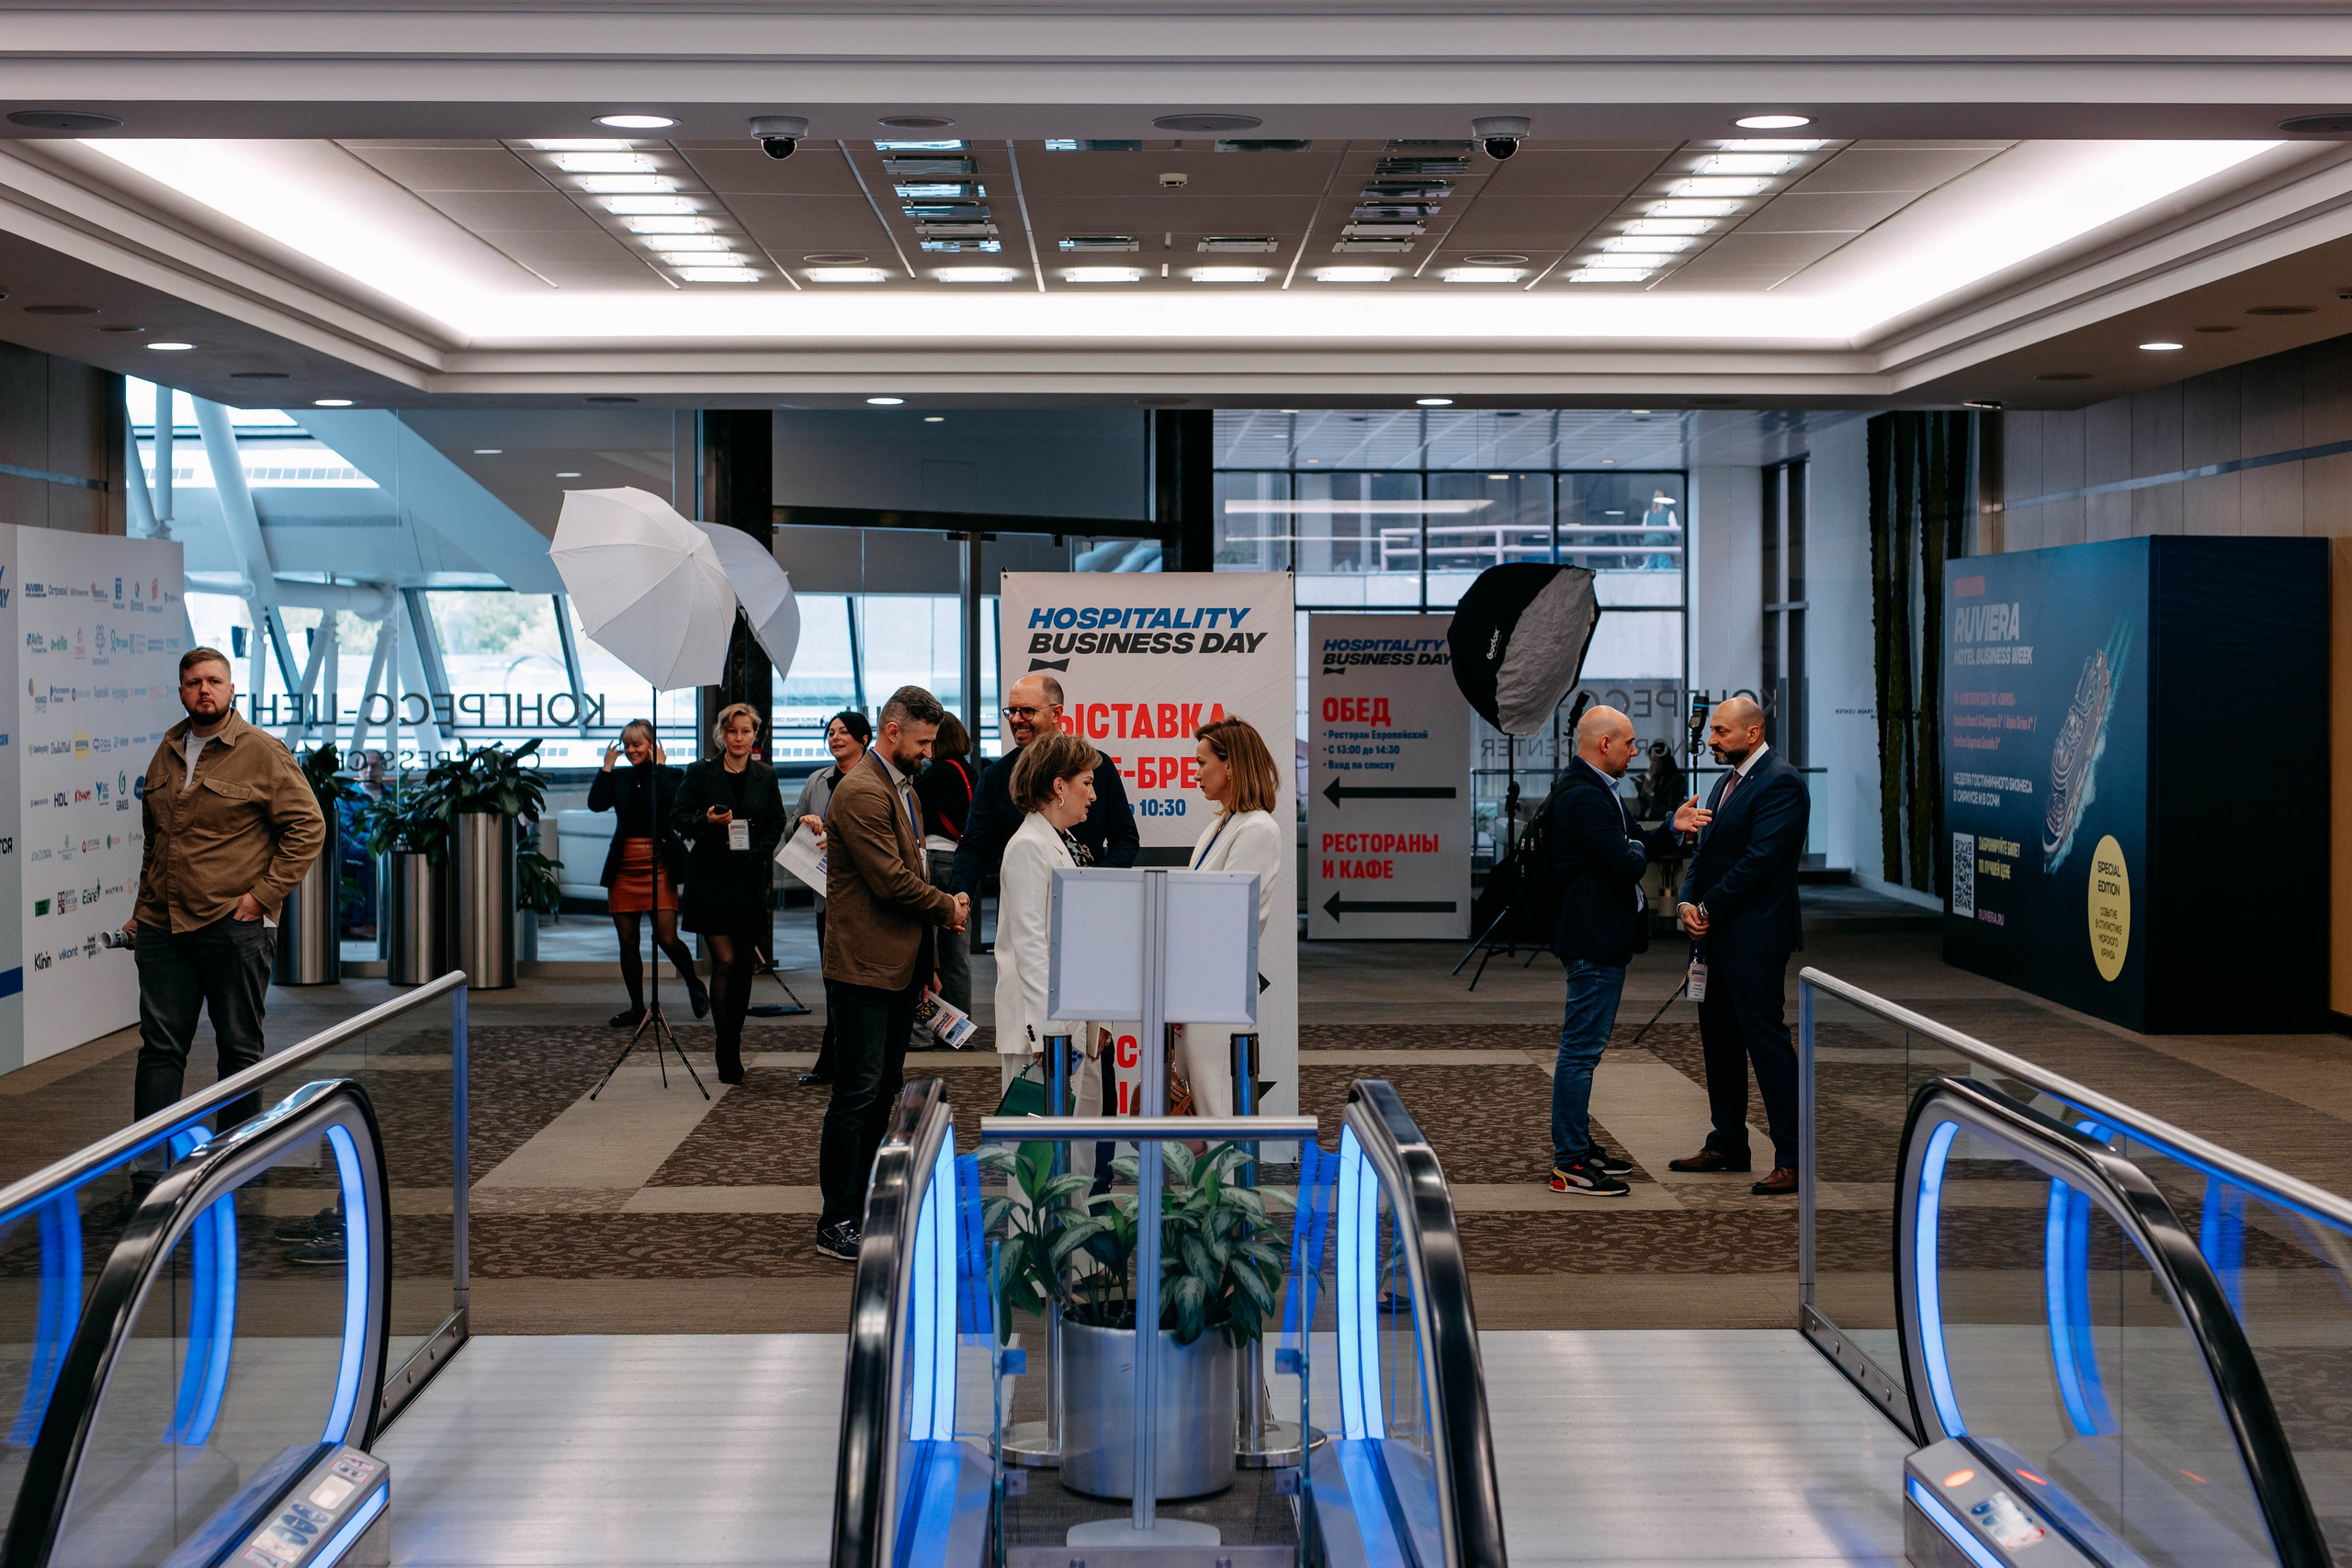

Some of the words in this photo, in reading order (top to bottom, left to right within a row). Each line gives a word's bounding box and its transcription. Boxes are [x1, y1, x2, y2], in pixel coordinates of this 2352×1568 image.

[1028, 608, 1251, 629] HOSPITALITY
[1954, 603, 2019, 643] RUVIERA
[1028, 632, 1195, 654] BUSINESS
[1199, 633, 1268, 653] DAY
[1323, 639, 1445, 651] HOSPITALITY
[1486, 627, 1500, 660] Godox
[1323, 653, 1415, 665] BUSINESS
[1954, 648, 1975, 665] HOTEL
[1976, 647, 2011, 665] BUSINESS
[2012, 646, 2033, 664] WEEK
[1323, 697, 1391, 727] ОБЕД
[1329, 730, 1370, 740] Ресторан
[1372, 730, 1428, 740] Европейский
[1337, 745, 1361, 754] 13:00
[1363, 747, 1374, 756] до
[1376, 745, 1400, 754] 14:30
[1329, 760, 1351, 771] Вход
[1364, 761, 1395, 771] списку
[1953, 773, 1972, 787] НЕДЕЛЯ
[1972, 773, 2009, 791] ГОСТИНИЧНОГО
[2009, 777, 2033, 794] БИЗНЕСА
[54, 793, 68, 808] HDL
[117, 799, 129, 811] GRASS
[1958, 790, 1978, 805] СИРИУСЕ
[1986, 794, 2000, 807] СОЧИ
[1139, 799, 1186, 816] 10:30
[1323, 834, 1439, 852] РЕСТОРАНЫ
[1323, 860, 1334, 878] И
[1340, 860, 1394, 879] КАФЕ
[2098, 861, 2121, 877] SPECIAL
[105, 886, 123, 897] MATRIX
[2098, 880, 2120, 897] EDITION
[1979, 908, 2005, 926] RUVIERA.RU
[58, 946, 78, 961] vikont
